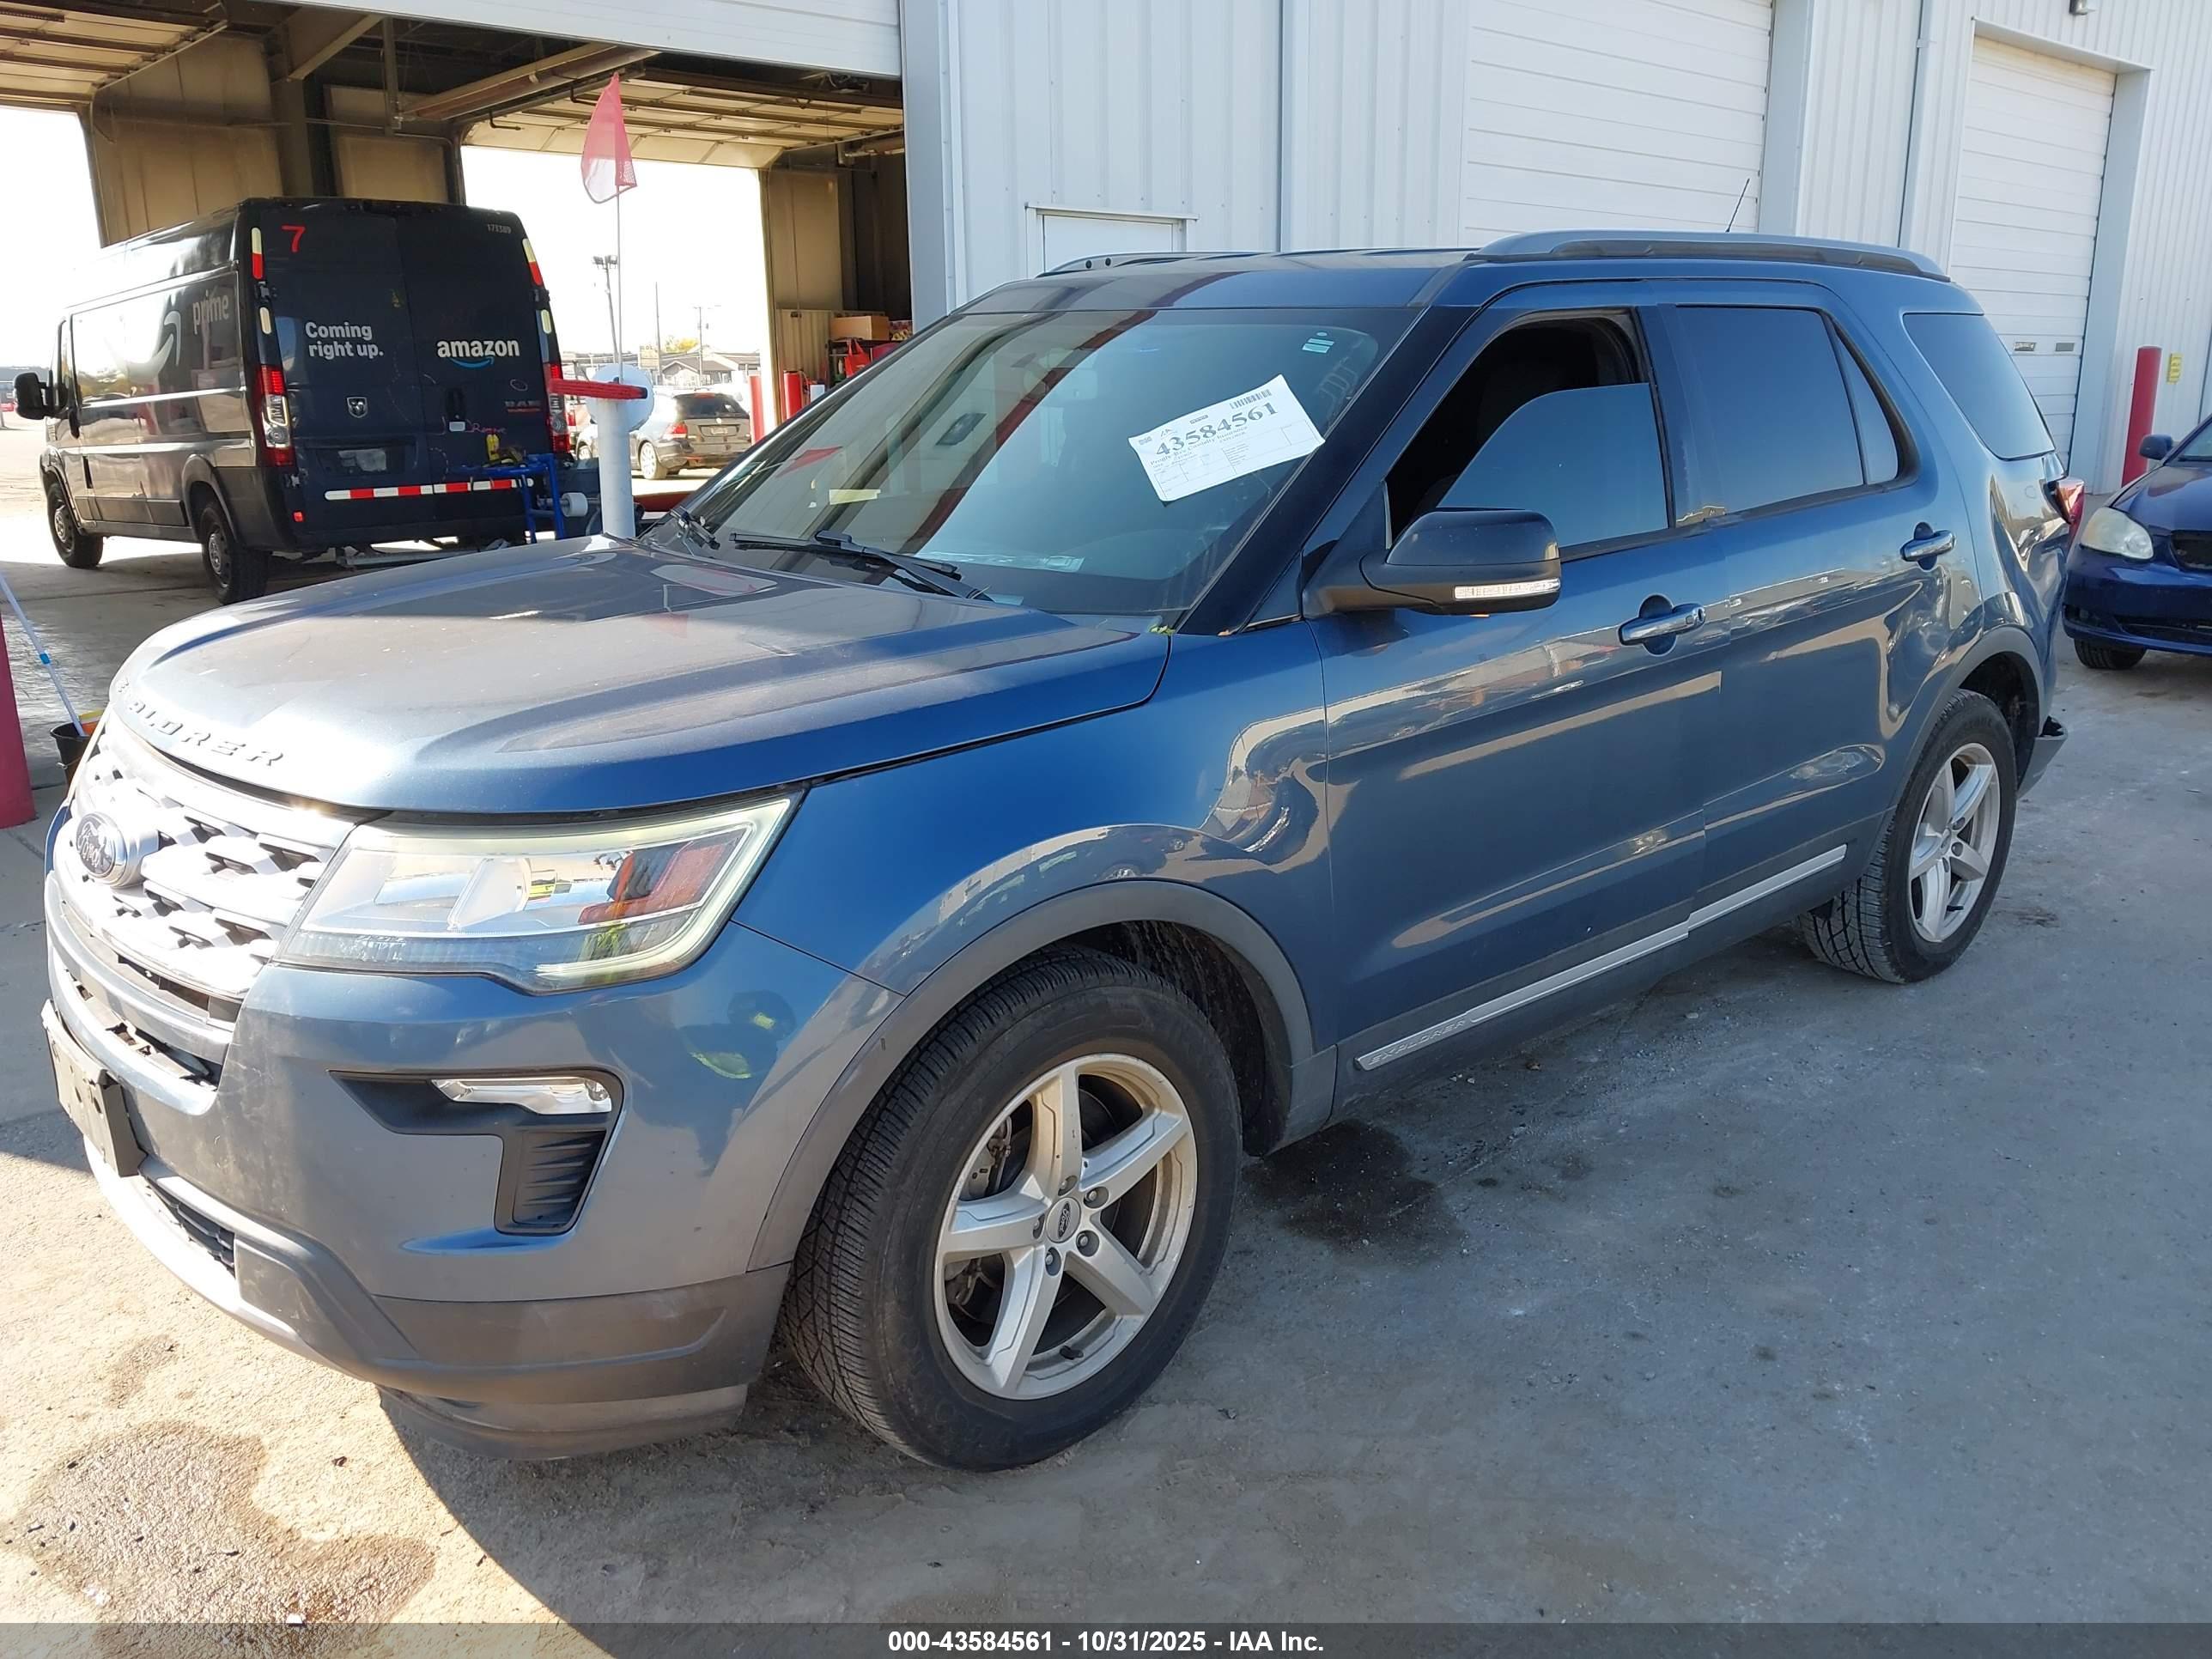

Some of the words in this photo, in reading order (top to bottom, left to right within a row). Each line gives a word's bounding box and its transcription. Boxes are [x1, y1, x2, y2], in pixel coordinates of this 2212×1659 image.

[282, 225, 307, 252] 7
[192, 289, 229, 335] prime
[305, 321, 373, 341] Coming
[309, 340, 354, 360] right
[356, 343, 384, 359] up.
[436, 339, 520, 358] amazon
[1156, 401, 1278, 456] 43584561
[1367, 1019, 1466, 1066] EXPLORER
[1059, 1206, 1071, 1234] Ford
